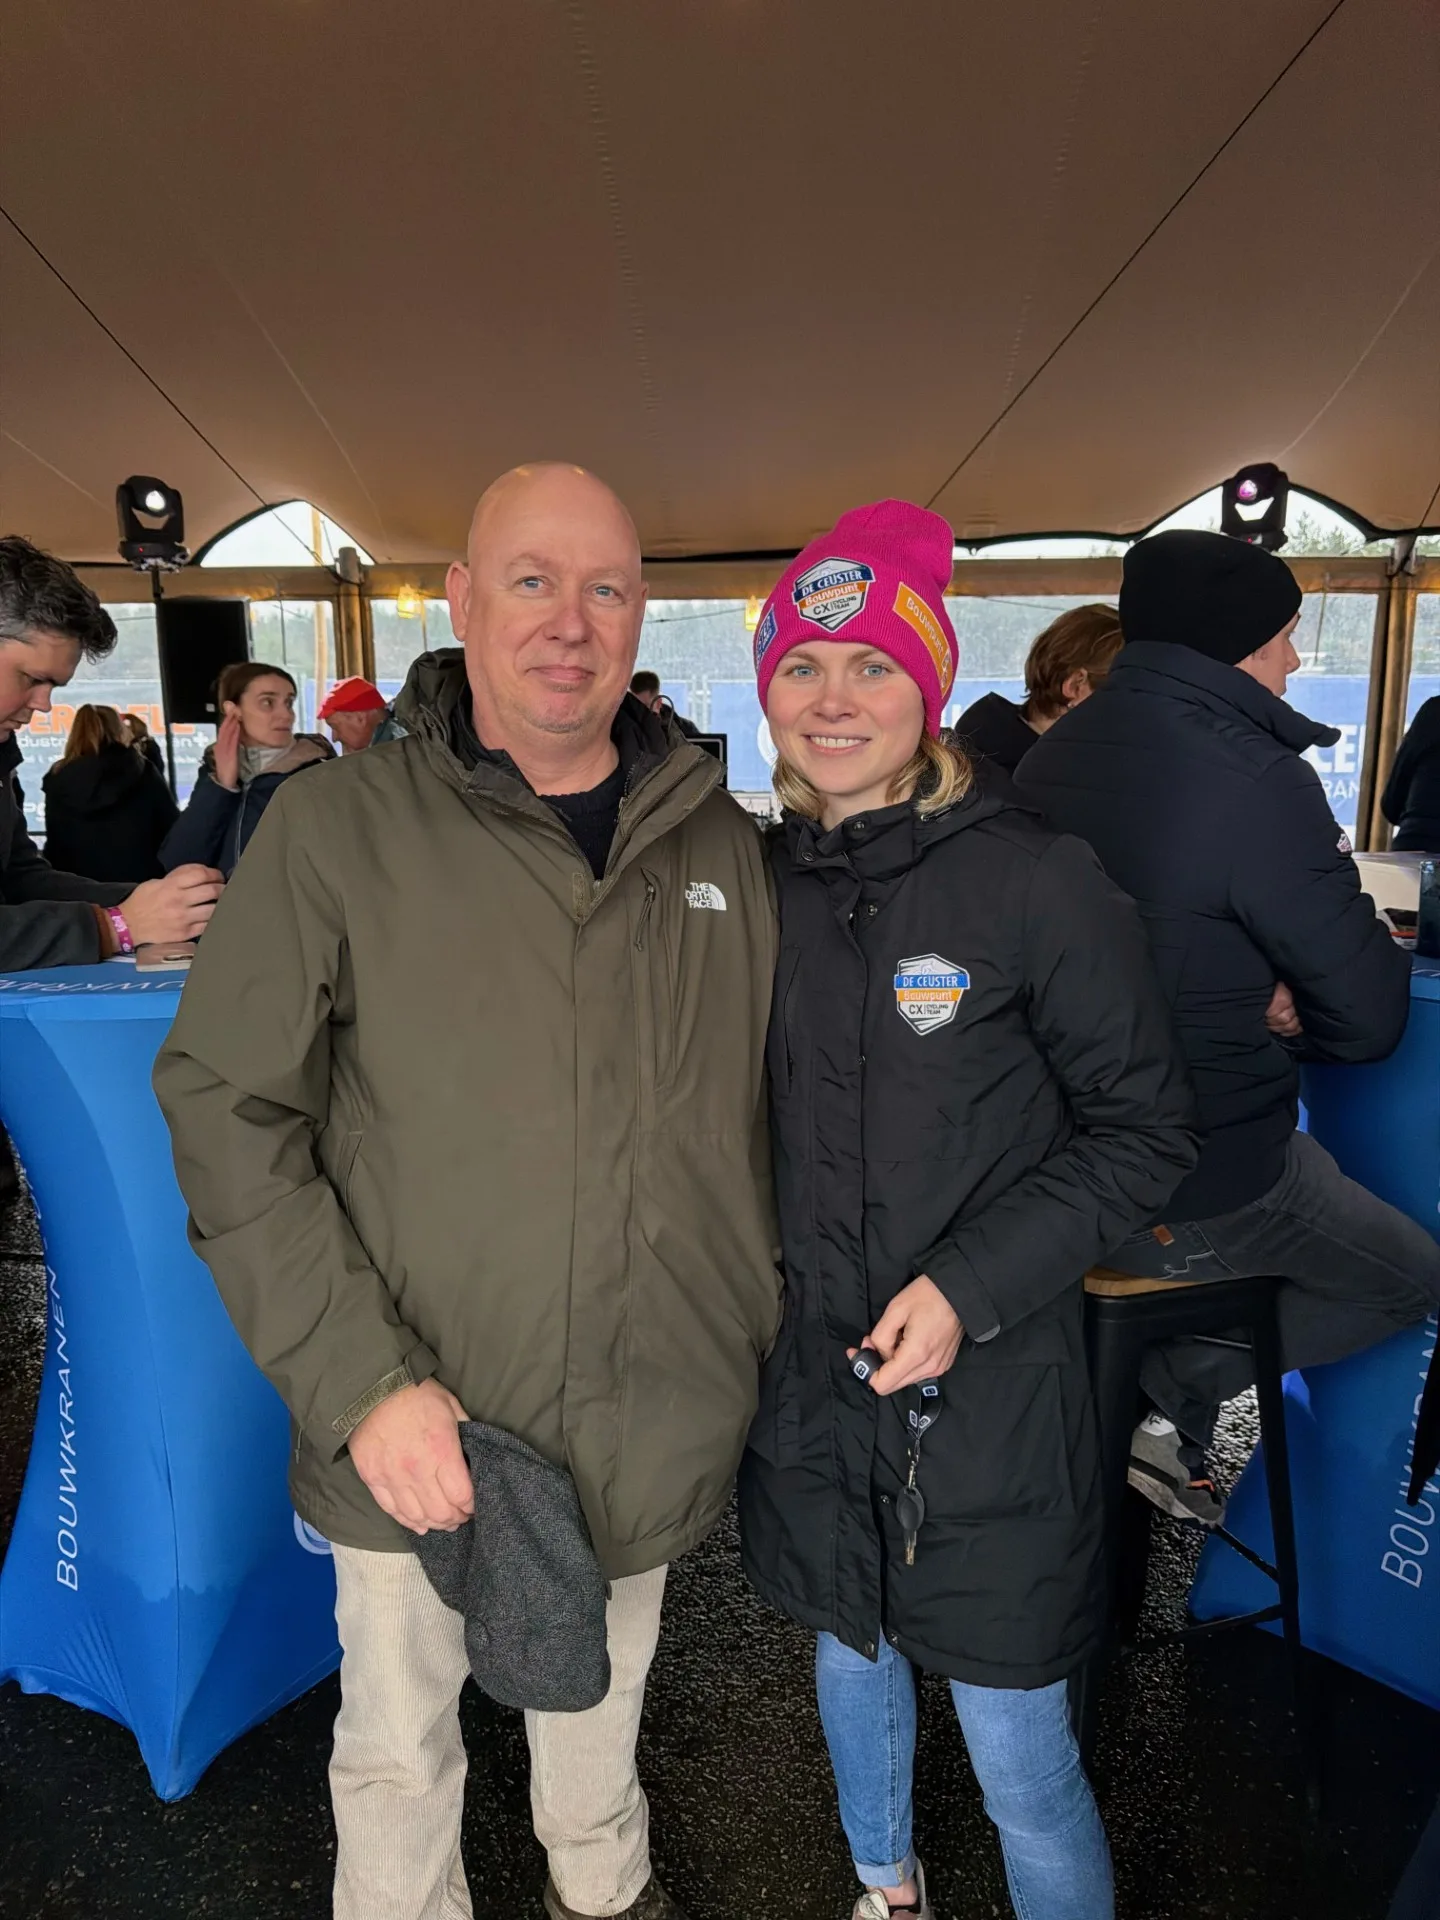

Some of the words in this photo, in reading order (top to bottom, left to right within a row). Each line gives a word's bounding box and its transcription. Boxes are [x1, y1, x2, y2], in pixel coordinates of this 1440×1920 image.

[802, 585, 816, 597] DE
[817, 570, 863, 589] CEUSTER
[805, 583, 860, 606] Bouwpunt
[813, 604, 831, 615] CX
[833, 596, 857, 604] CYCLING
[690, 882, 709, 891] THE
[685, 889, 710, 900] ORTH
[689, 900, 712, 908] FACE
[903, 977, 914, 987] DE
[917, 976, 958, 987] CEUSTER
[904, 990, 952, 1001] Bouwpunt
[909, 1004, 923, 1015] CX
[47, 1264, 79, 1592] BOUWKRANEN
